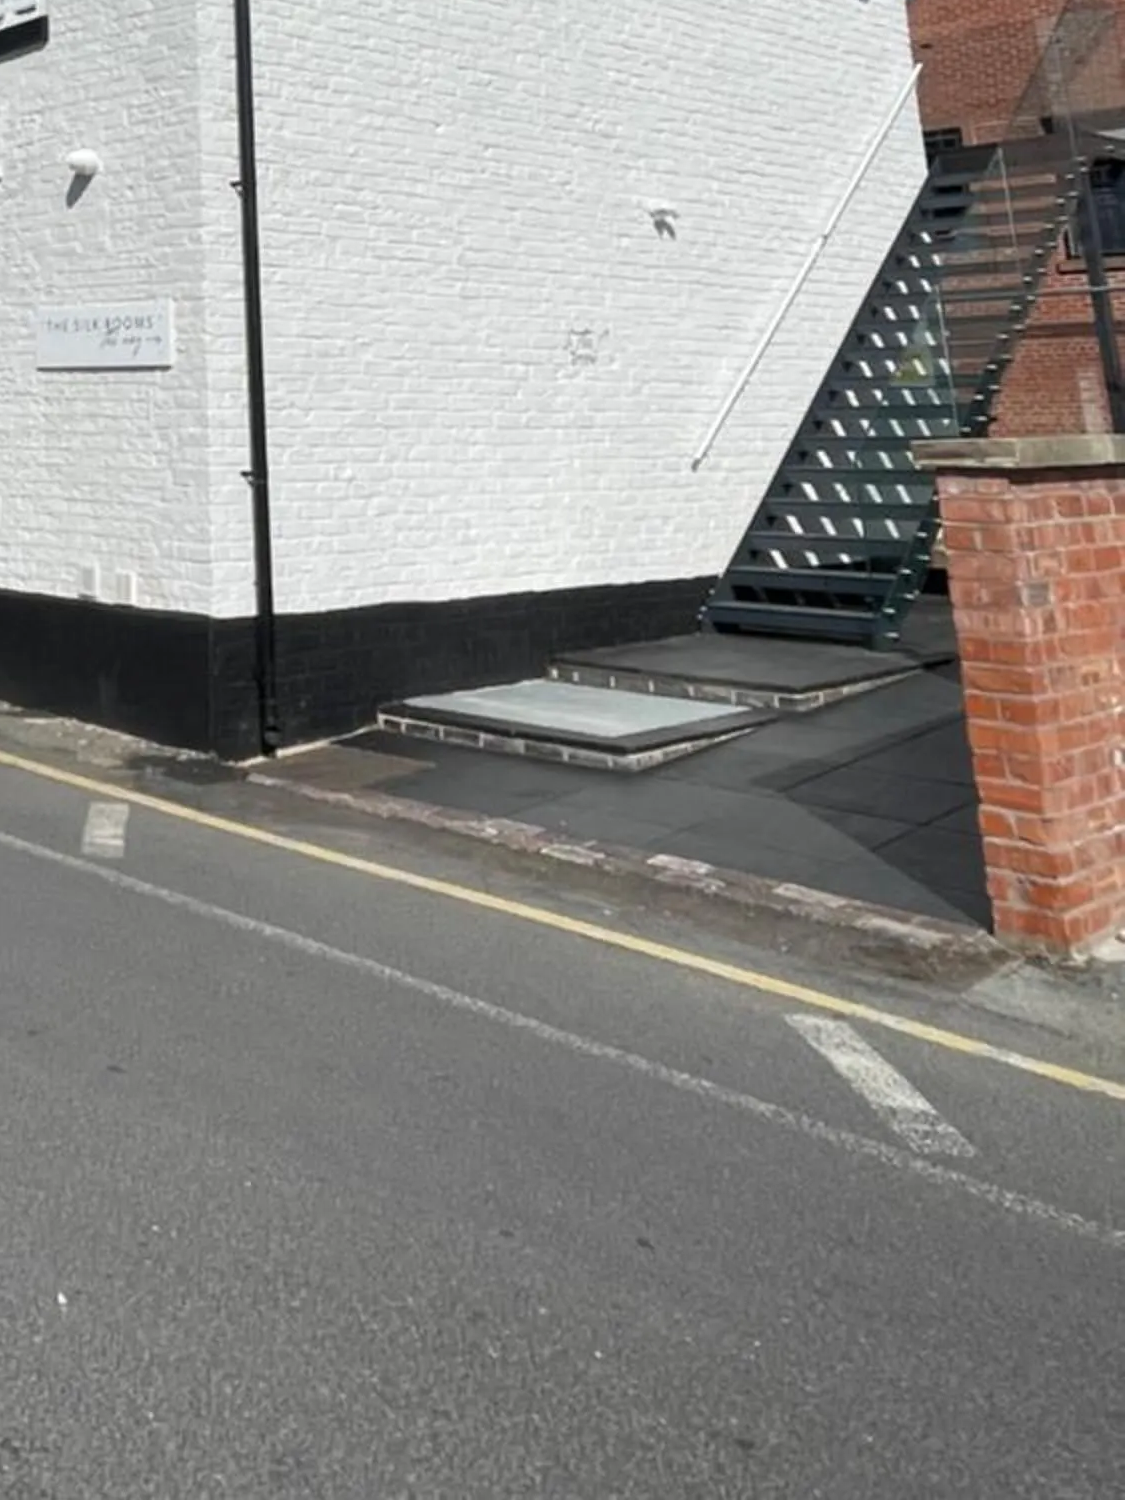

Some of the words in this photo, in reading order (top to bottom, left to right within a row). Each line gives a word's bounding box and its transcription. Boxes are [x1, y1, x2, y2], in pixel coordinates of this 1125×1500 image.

[46, 315, 69, 332] THE
[73, 316, 99, 332] SILK
[104, 314, 154, 331] ROOMS
